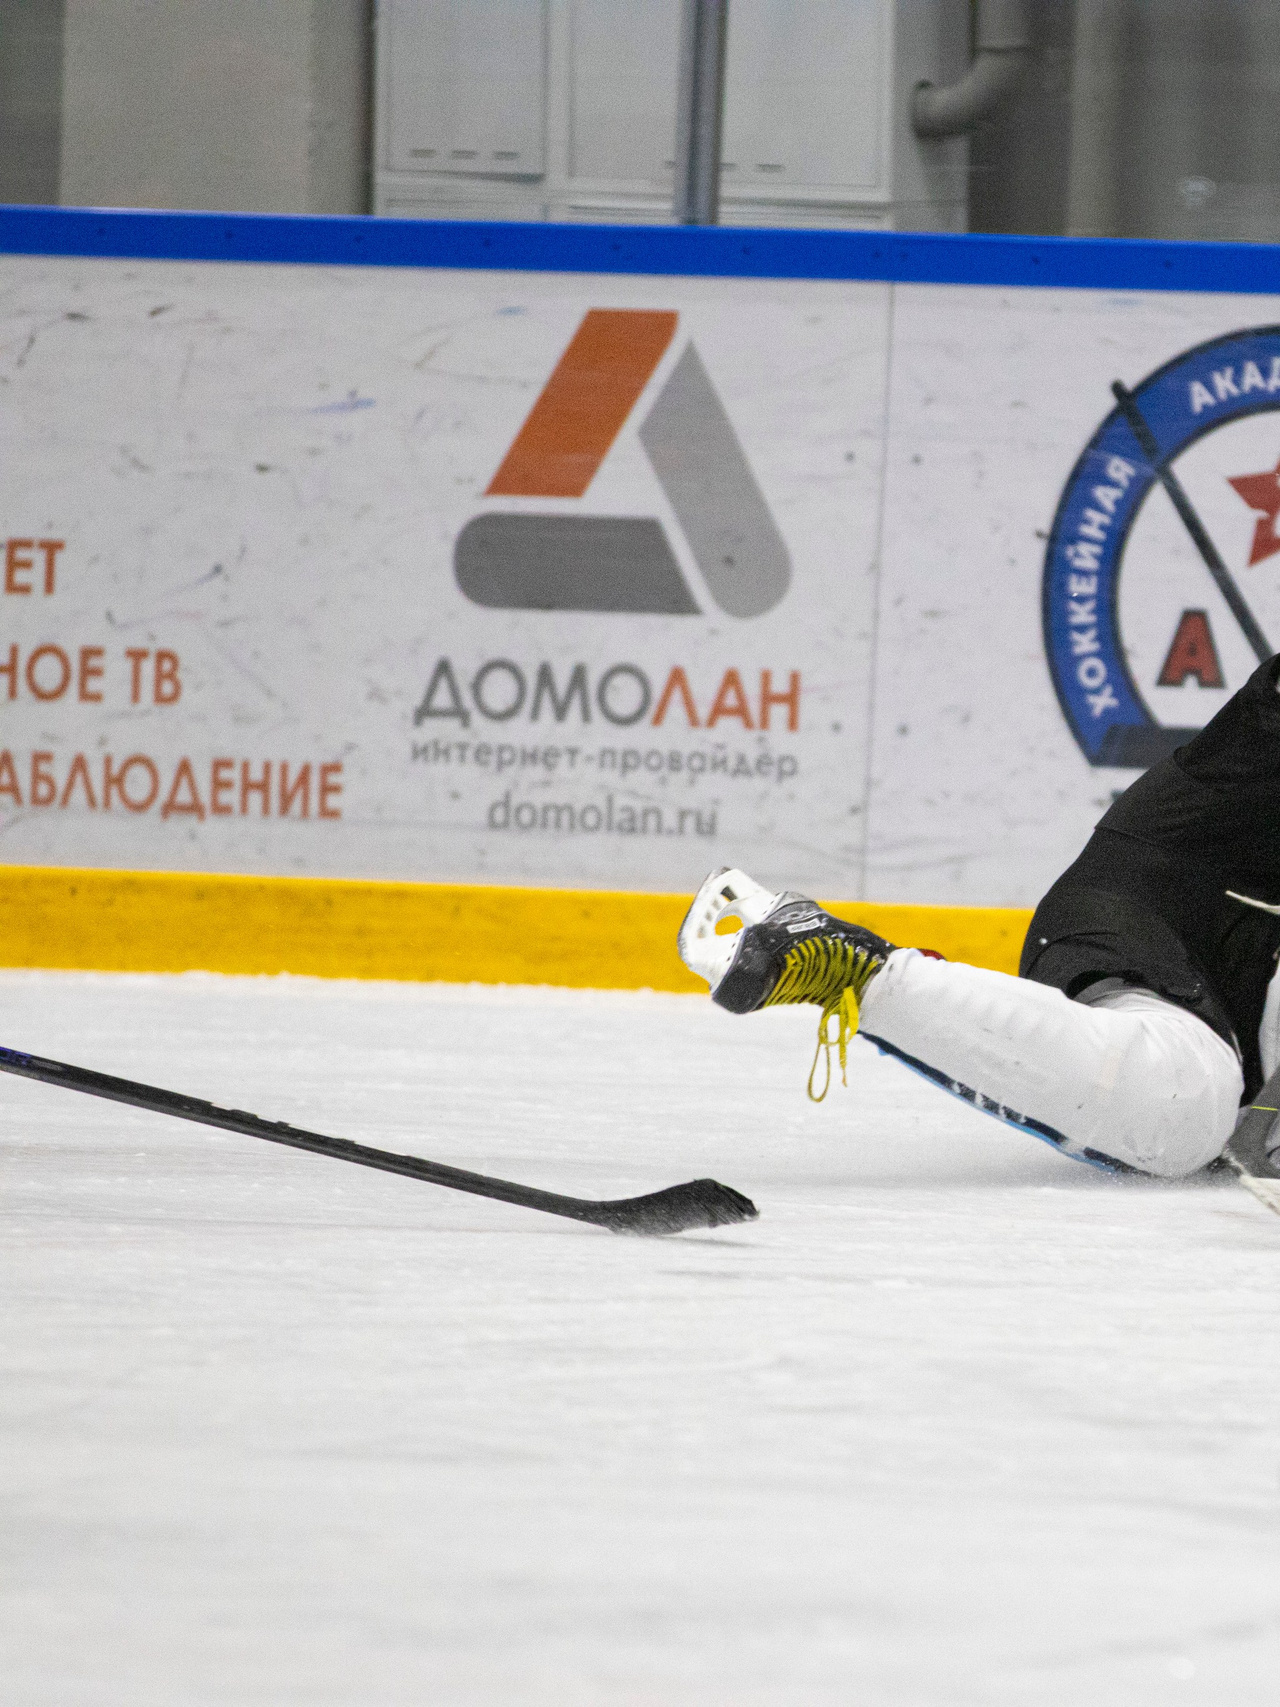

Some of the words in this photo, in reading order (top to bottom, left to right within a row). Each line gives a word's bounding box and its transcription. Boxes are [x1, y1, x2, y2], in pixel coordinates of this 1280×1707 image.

[1065, 456, 1137, 718] ХОККЕЙНАЯ
[124, 646, 183, 705] ТВ
[1156, 608, 1227, 690] А
[412, 656, 802, 733] ДОМОЛАН
[410, 738, 800, 784] интернет-провайдер
[486, 789, 719, 837] domolan.ru
